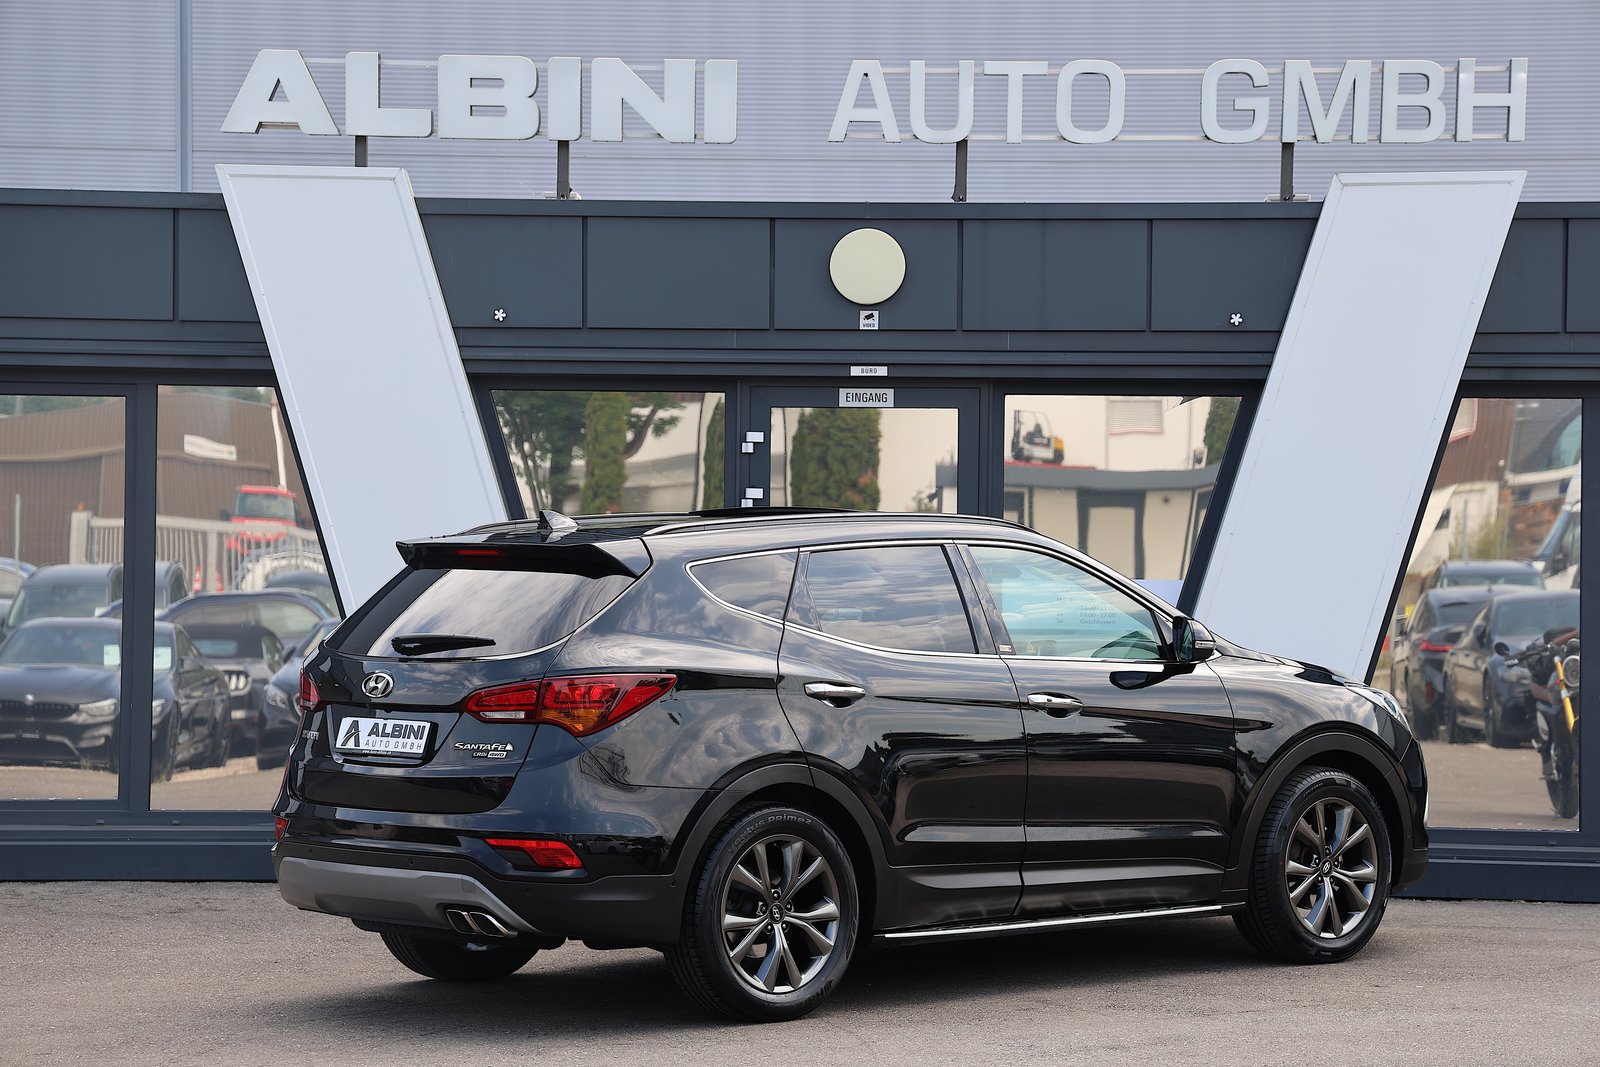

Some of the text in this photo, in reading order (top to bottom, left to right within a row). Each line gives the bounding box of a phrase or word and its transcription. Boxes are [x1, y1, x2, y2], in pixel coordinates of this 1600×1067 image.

[221, 49, 1529, 144] ALBINI AUTO GMBH
[846, 392, 888, 403] EINGANG
[367, 722, 427, 741] ALBINI
[364, 739, 424, 751] AUTO GMBH
